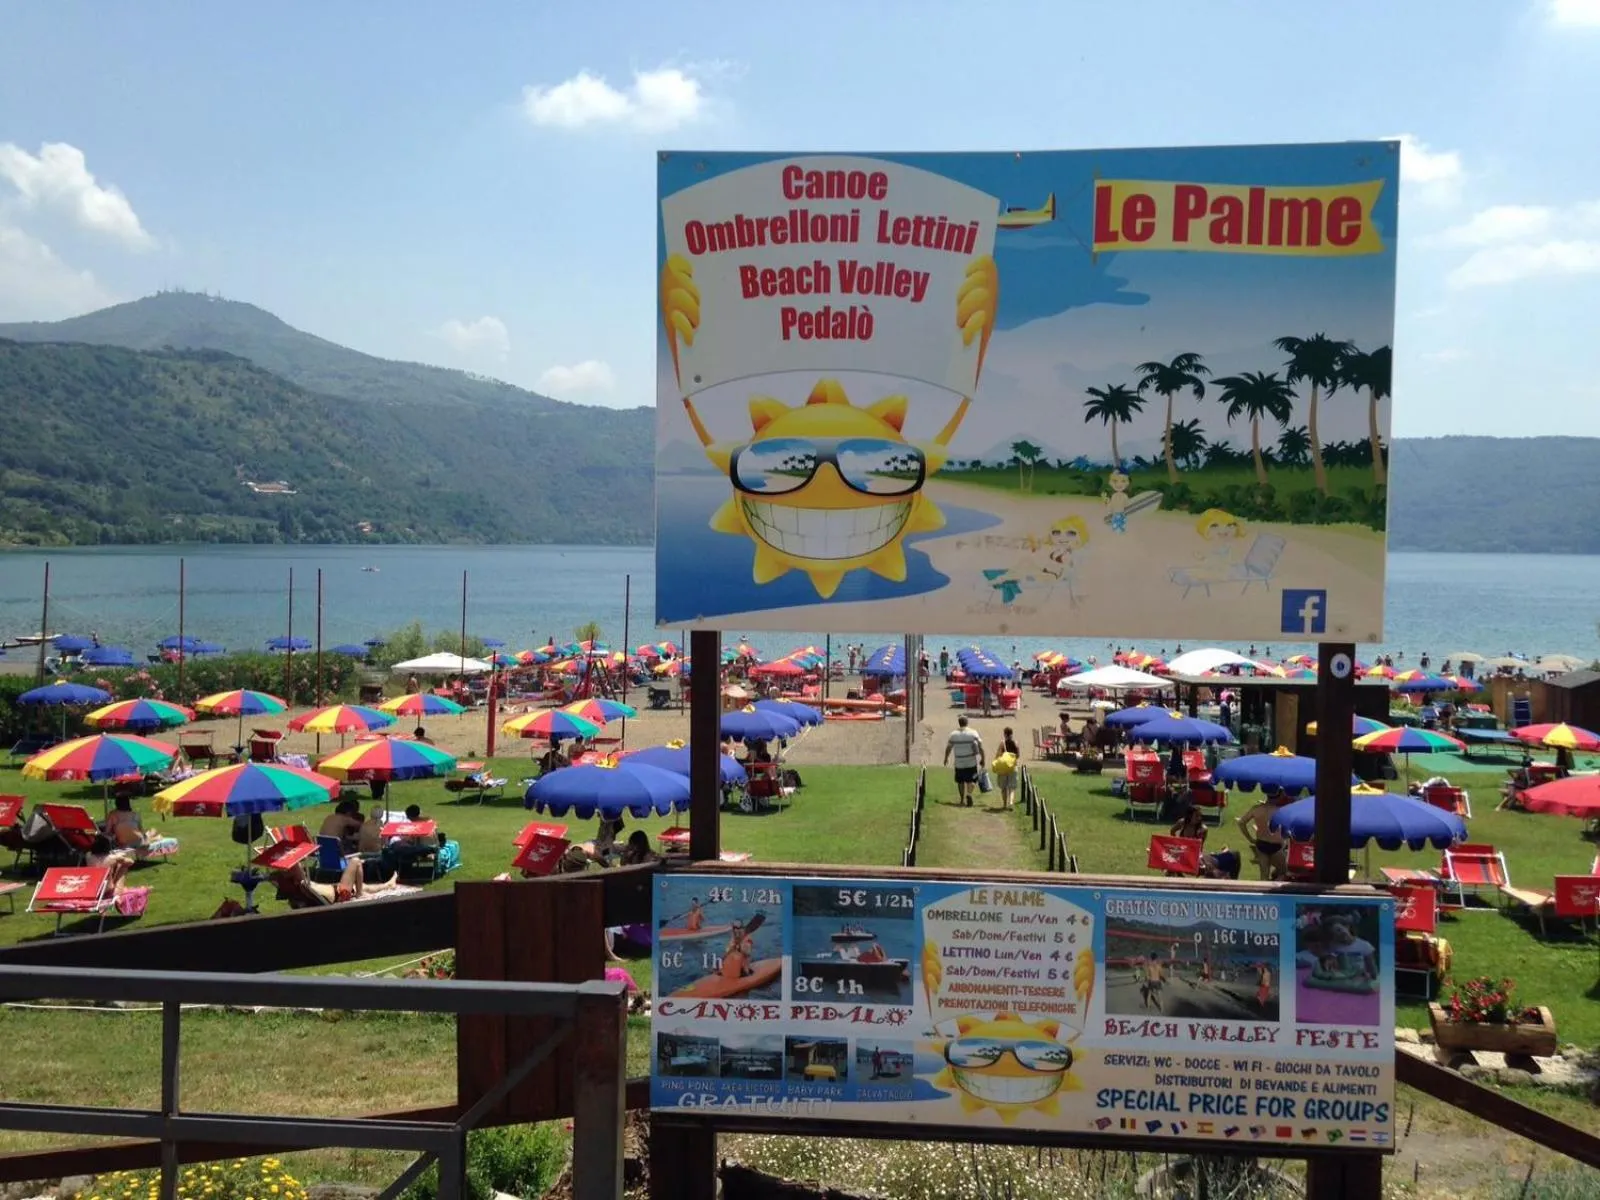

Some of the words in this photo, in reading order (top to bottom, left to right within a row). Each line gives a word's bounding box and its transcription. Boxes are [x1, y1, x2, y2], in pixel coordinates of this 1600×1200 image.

[782, 164, 888, 200] Canoe
[1094, 184, 1157, 243] Le
[1172, 183, 1363, 247] Palme
[684, 208, 860, 256] Ombrelloni
[877, 210, 979, 254] Lettini
[739, 262, 832, 300] Beach
[838, 259, 930, 303] Volley
[780, 304, 875, 341] Pedalò
[708, 886, 734, 902] 4€
[741, 887, 782, 905] 1/2h
[838, 890, 868, 906] 5€
[875, 891, 914, 908] 1/2h
[970, 889, 988, 905] LE
[993, 890, 1046, 908] PALME
[927, 909, 1004, 923] OMBRELLONE
[1010, 912, 1059, 925] Lun/Ven
[1066, 914, 1077, 925] 4
[1105, 900, 1158, 917] GRATIS
[1159, 902, 1191, 918] CON
[1193, 903, 1212, 919] UN
[1214, 903, 1279, 921] LETTINO
[952, 928, 1046, 943] Sab/Dom/Festivi
[1053, 932, 1064, 944] 5
[1242, 929, 1280, 947] l'ora
[662, 950, 684, 969] 6€
[701, 952, 723, 970] 1h
[942, 946, 991, 959] LETTINO
[994, 948, 1043, 961] Lun/Ven
[1049, 950, 1061, 962] 4
[946, 965, 1040, 979] Sab/Dom/Festivi
[1047, 968, 1058, 980] 5
[795, 976, 823, 993] 8€
[837, 978, 864, 996] 1h
[658, 1001, 780, 1021] CANOE
[938, 998, 1009, 1011] PRENOTAZIONI
[1104, 1018, 1178, 1038] BEACH
[1188, 1021, 1280, 1043] VOLLEY
[1295, 1029, 1379, 1049] FESTE
[1154, 1057, 1172, 1068] WC
[1184, 1059, 1221, 1071] DOCCE
[1275, 1062, 1312, 1076] GIOCHI
[1316, 1064, 1331, 1076] DA
[1335, 1064, 1380, 1078] TAVOLO
[788, 1085, 814, 1097] BABY
[1155, 1074, 1233, 1089] DISTRIBUTORI
[1240, 1078, 1251, 1089] DI
[1255, 1079, 1308, 1093] BEVANDE
[1311, 1081, 1319, 1093] E
[1322, 1081, 1377, 1096] ALIMENTI
[1096, 1088, 1181, 1113] SPECIAL
[1188, 1092, 1248, 1116] PRICE
[1255, 1096, 1296, 1119] FOR
[1304, 1098, 1390, 1123] GROUPS
